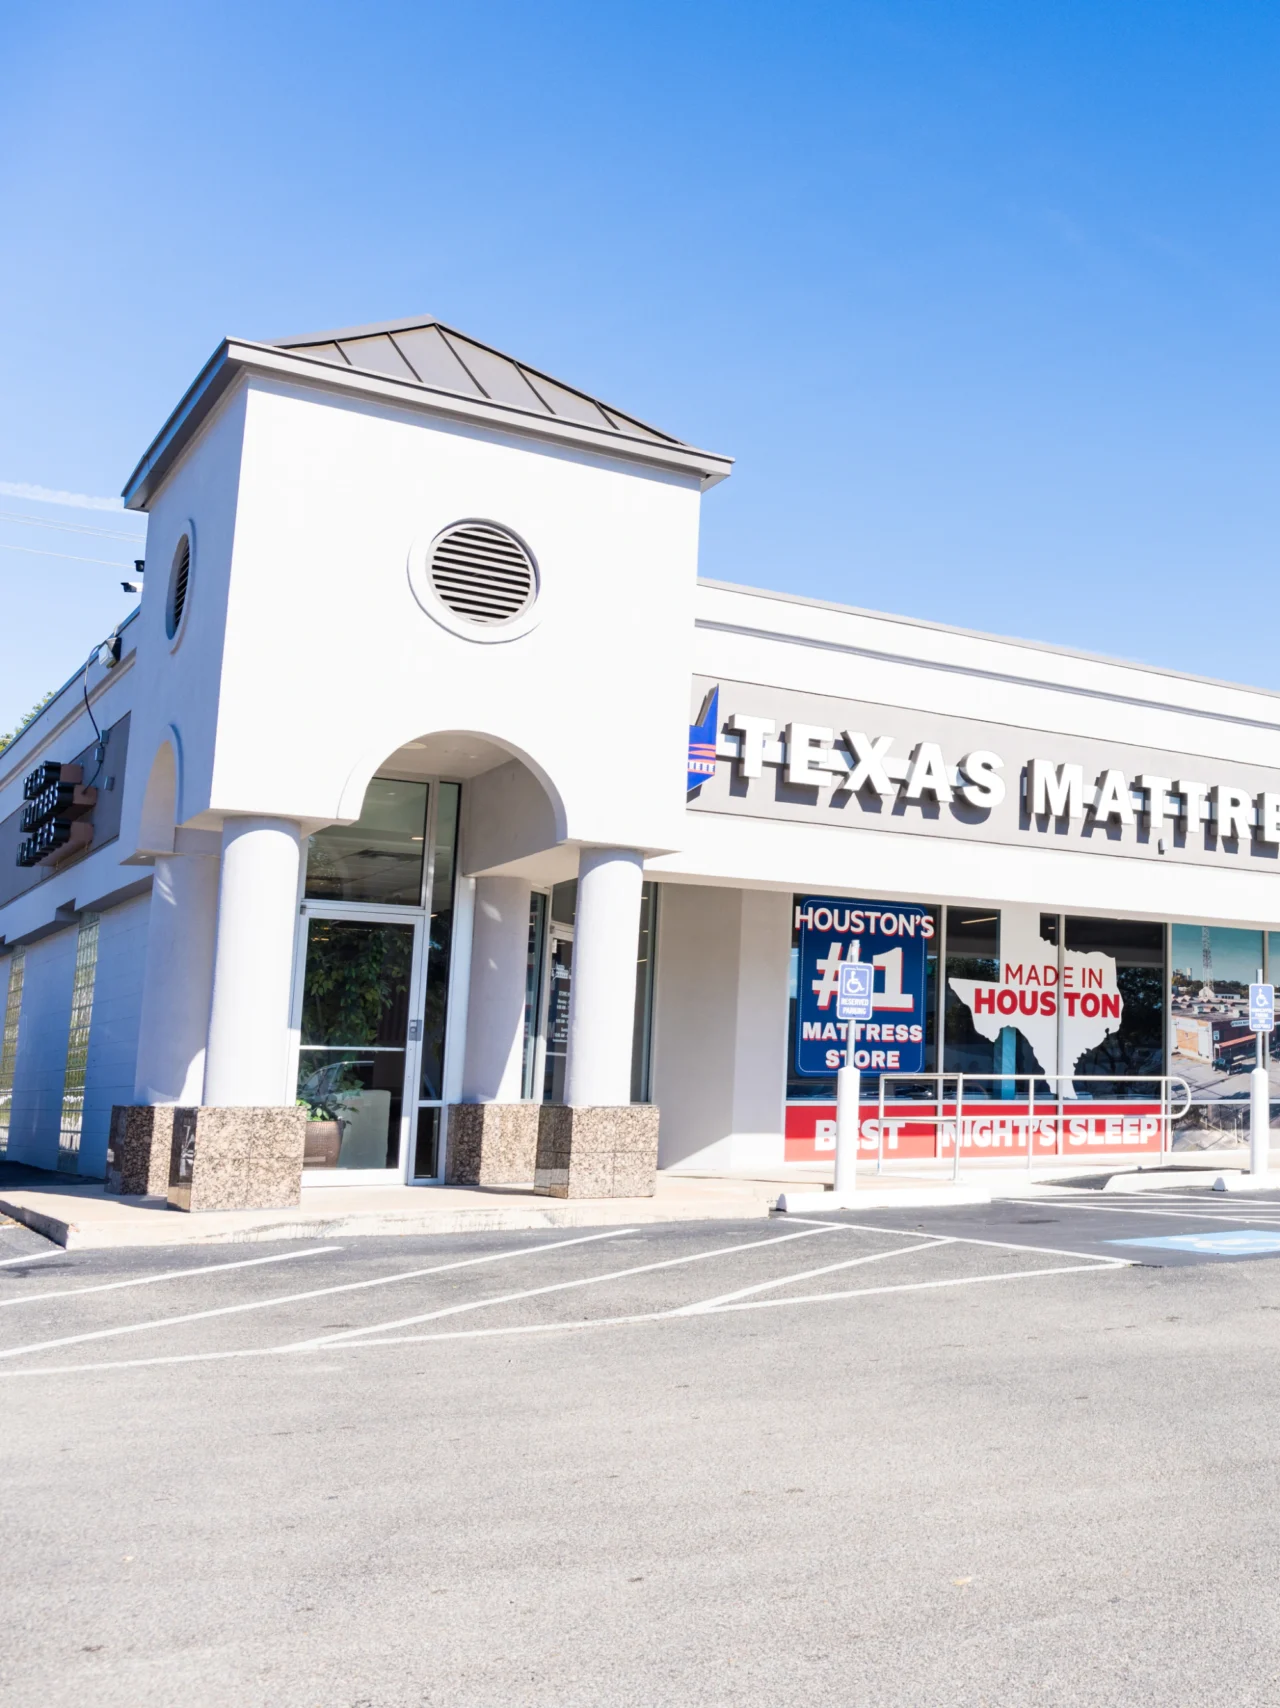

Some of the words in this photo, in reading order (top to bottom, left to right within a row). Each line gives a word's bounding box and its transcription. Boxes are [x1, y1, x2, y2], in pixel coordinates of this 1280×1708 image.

[728, 713, 1006, 807] TEXAS
[795, 905, 934, 938] HOUSTON'S
[1005, 963, 1074, 988] MADE
[1082, 967, 1103, 989] IN
[974, 988, 1120, 1018] HOUSTON
[803, 1022, 923, 1043] MATTRESS
[825, 1049, 901, 1069] STORE
[815, 1119, 906, 1150] BST
[942, 1118, 1056, 1148] NIGHT'S
[1069, 1117, 1159, 1146] SLEEP
